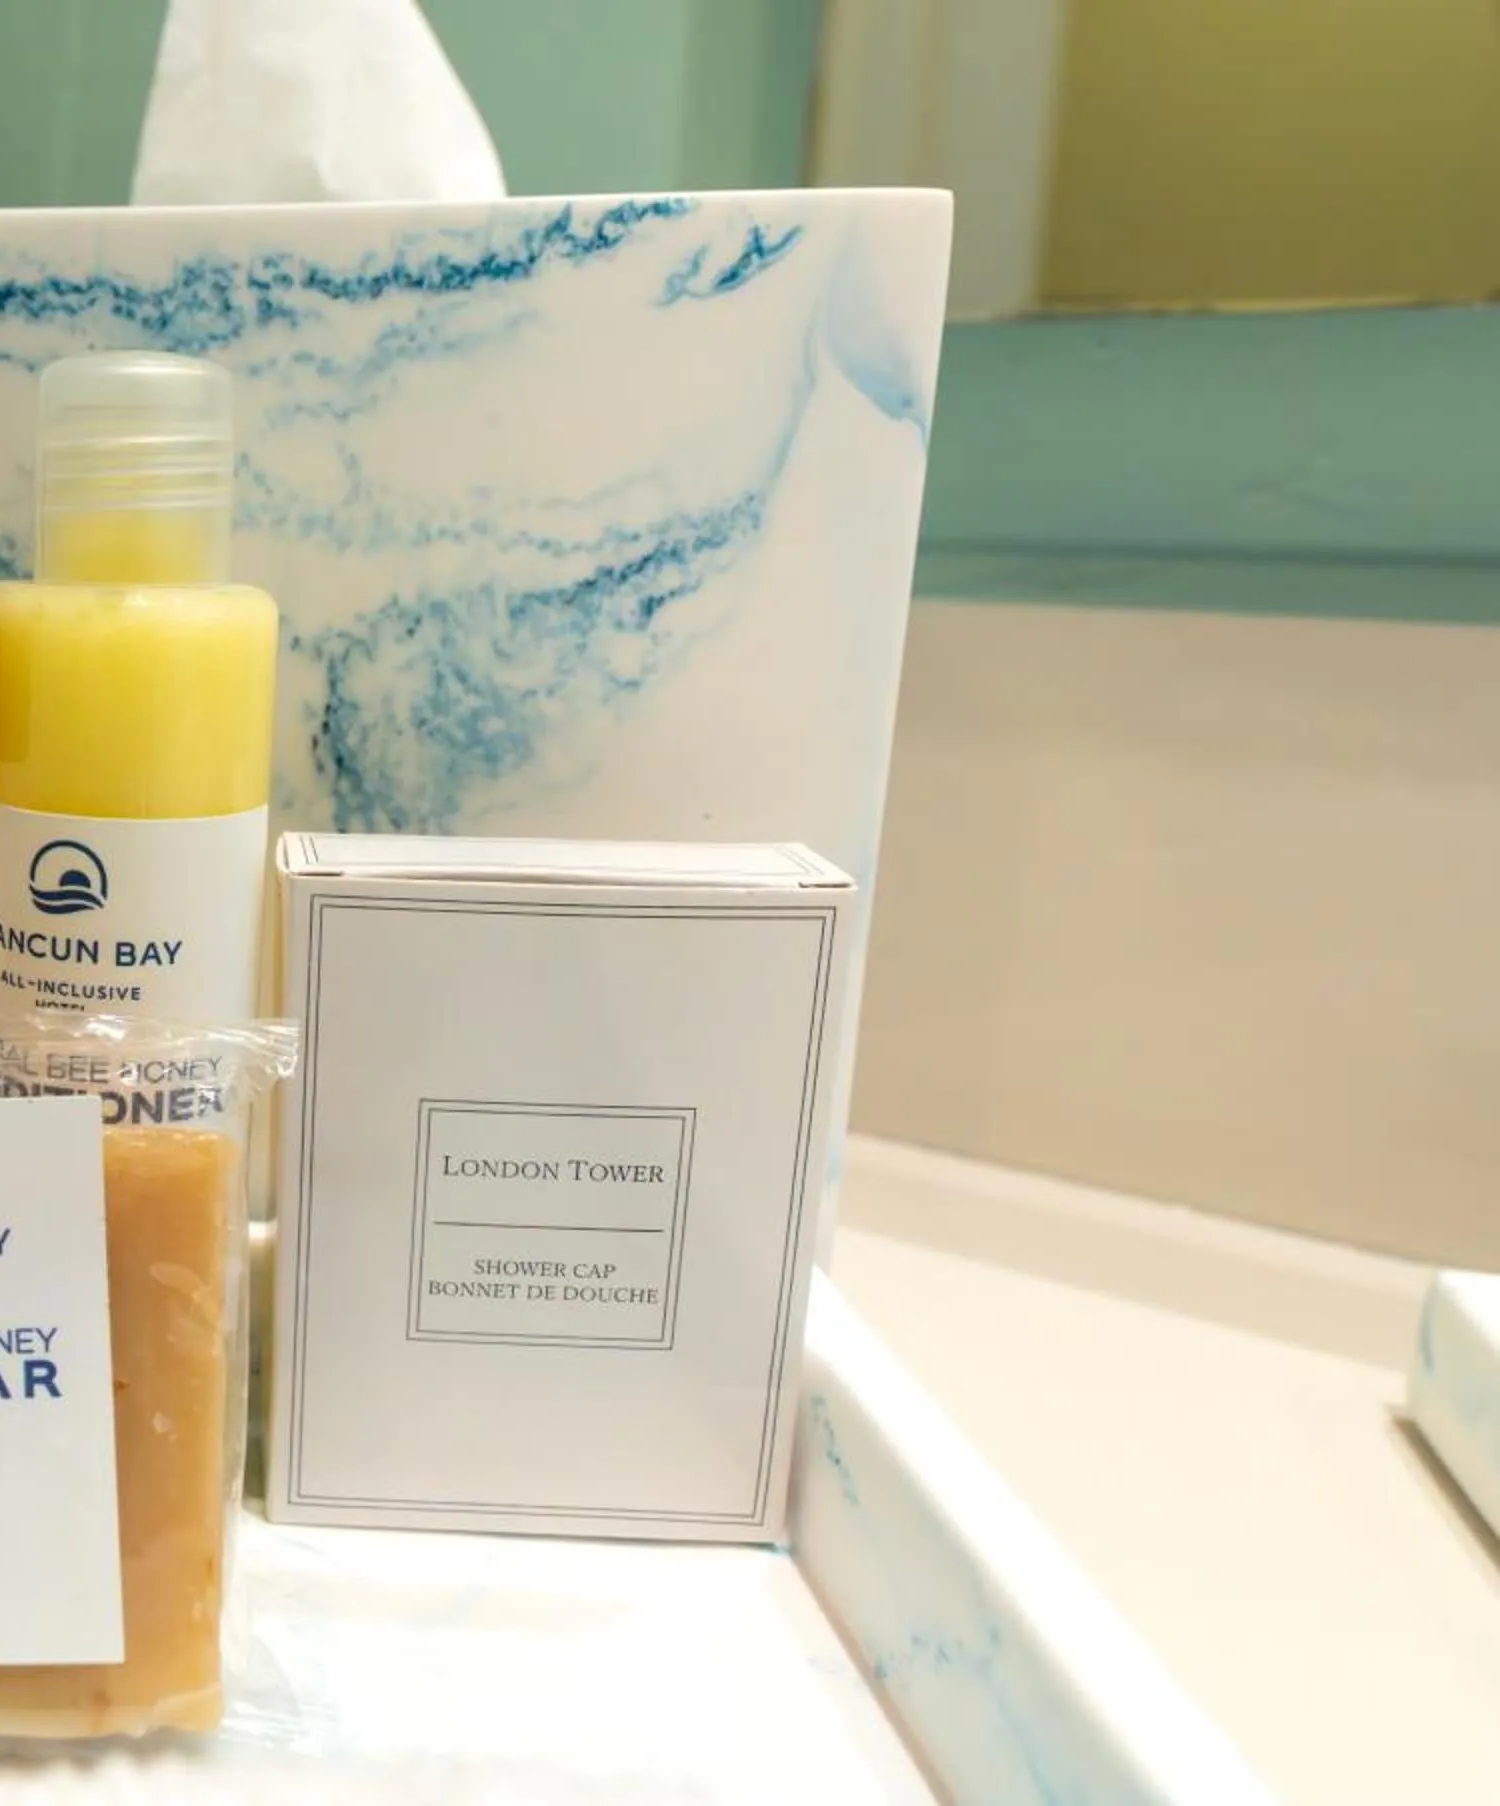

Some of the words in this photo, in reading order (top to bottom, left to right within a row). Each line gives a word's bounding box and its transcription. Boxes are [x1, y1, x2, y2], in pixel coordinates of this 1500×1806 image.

[114, 940, 182, 967] BAY
[46, 1053, 110, 1083] BEE
[443, 1155, 559, 1181] LONDON
[568, 1159, 665, 1183] TOWER
[473, 1259, 567, 1279] SHOWER
[572, 1263, 617, 1279] CAP
[428, 1280, 520, 1299] BONNET
[526, 1284, 556, 1301] DE
[563, 1285, 659, 1304] DOUCHE
